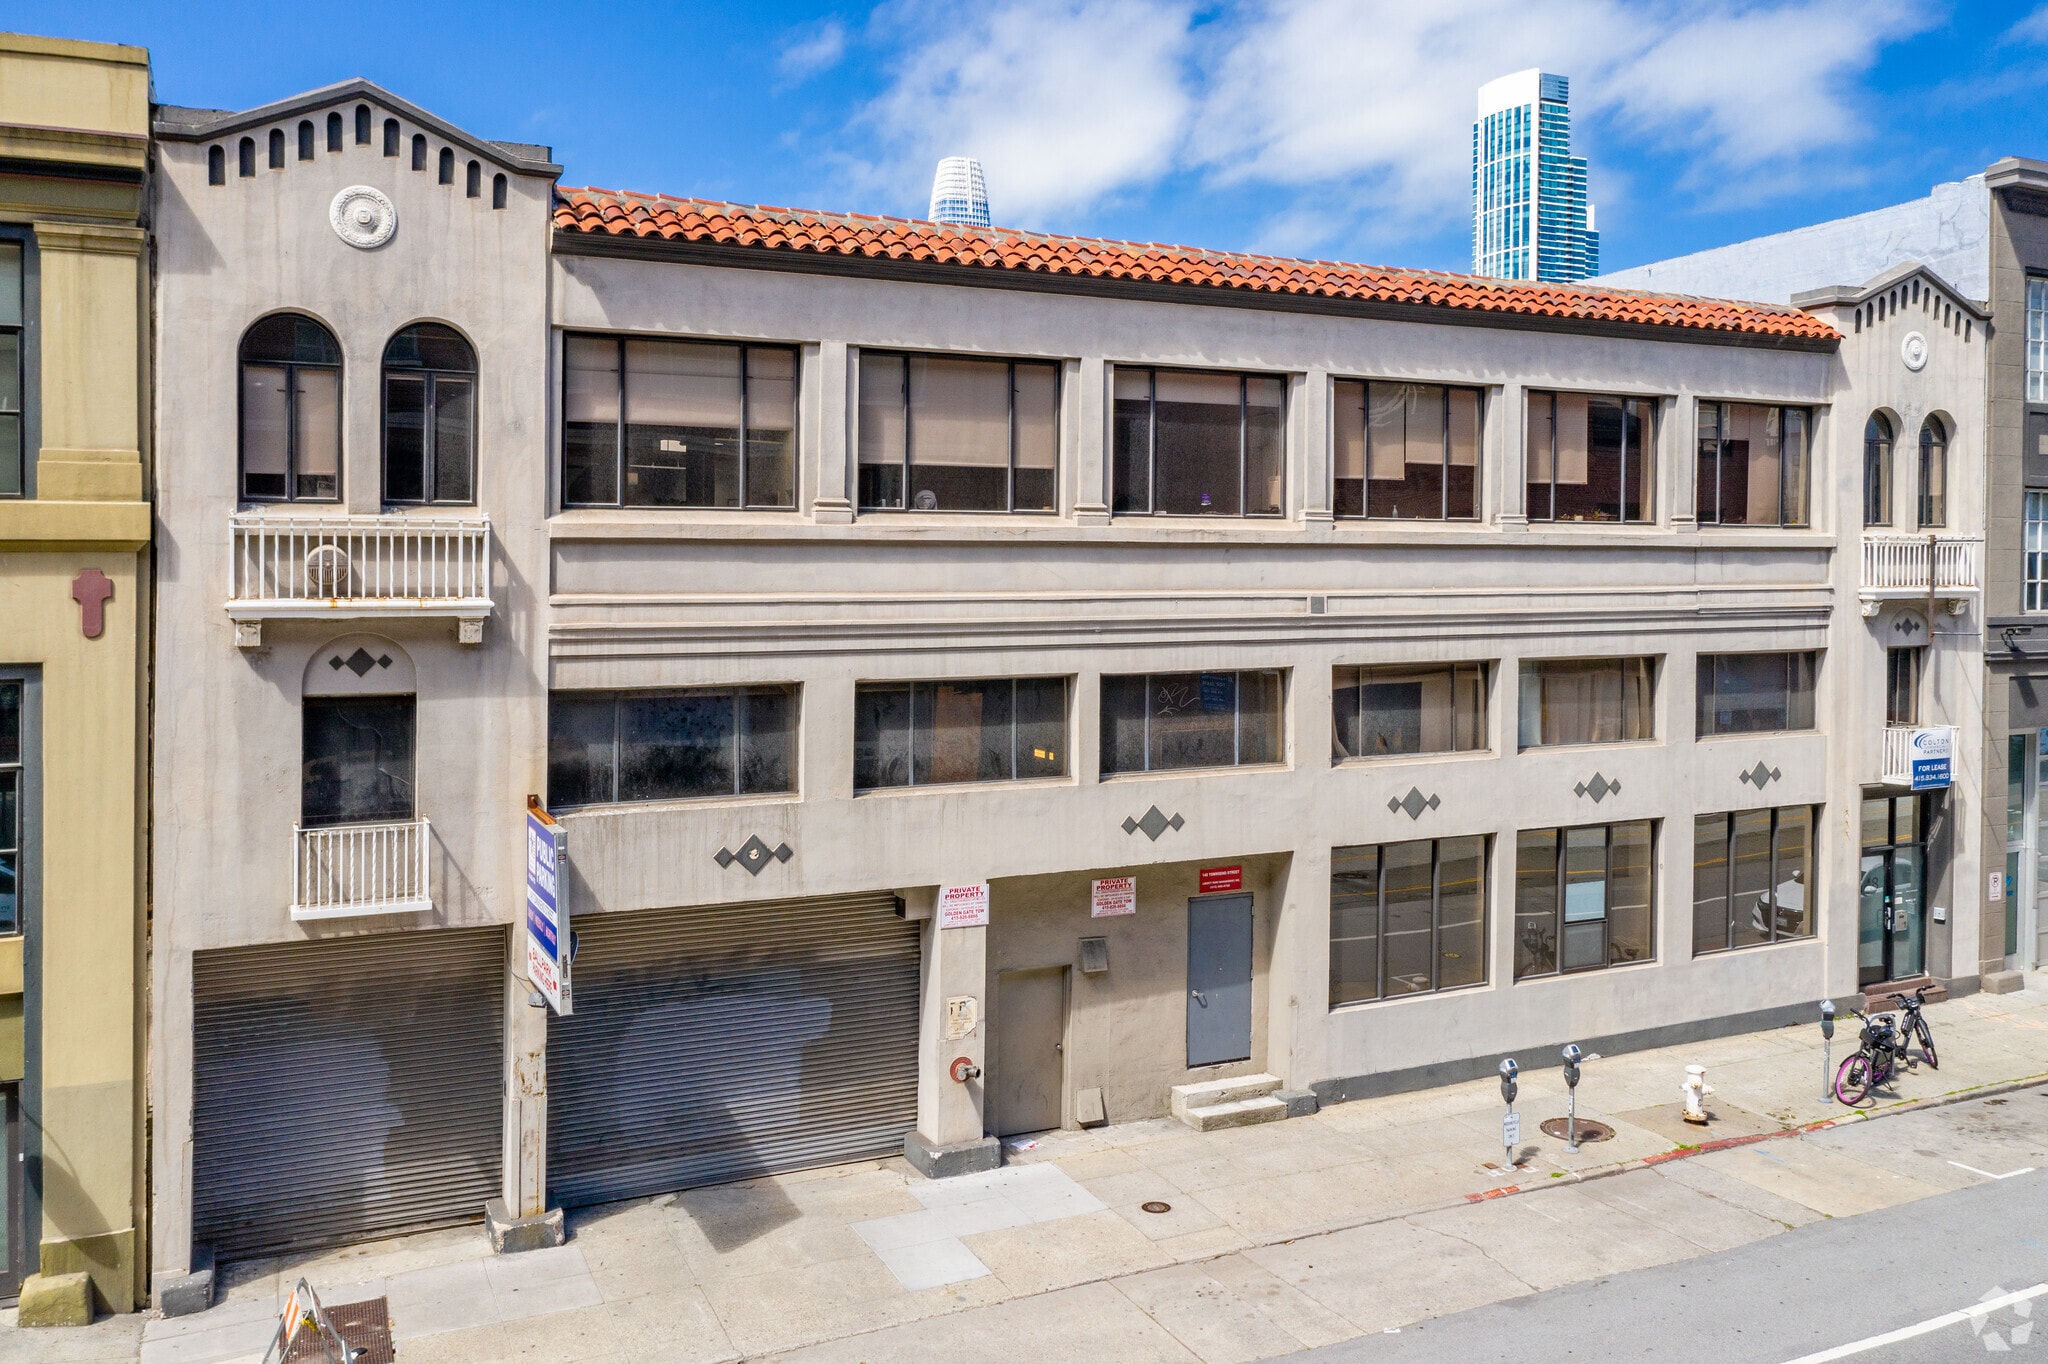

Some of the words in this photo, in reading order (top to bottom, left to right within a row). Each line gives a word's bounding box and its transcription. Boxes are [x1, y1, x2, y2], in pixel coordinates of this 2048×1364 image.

[1931, 763, 1947, 771] LEASE
[536, 835, 554, 871] PUBLIC
[536, 861, 556, 898] PARKING
